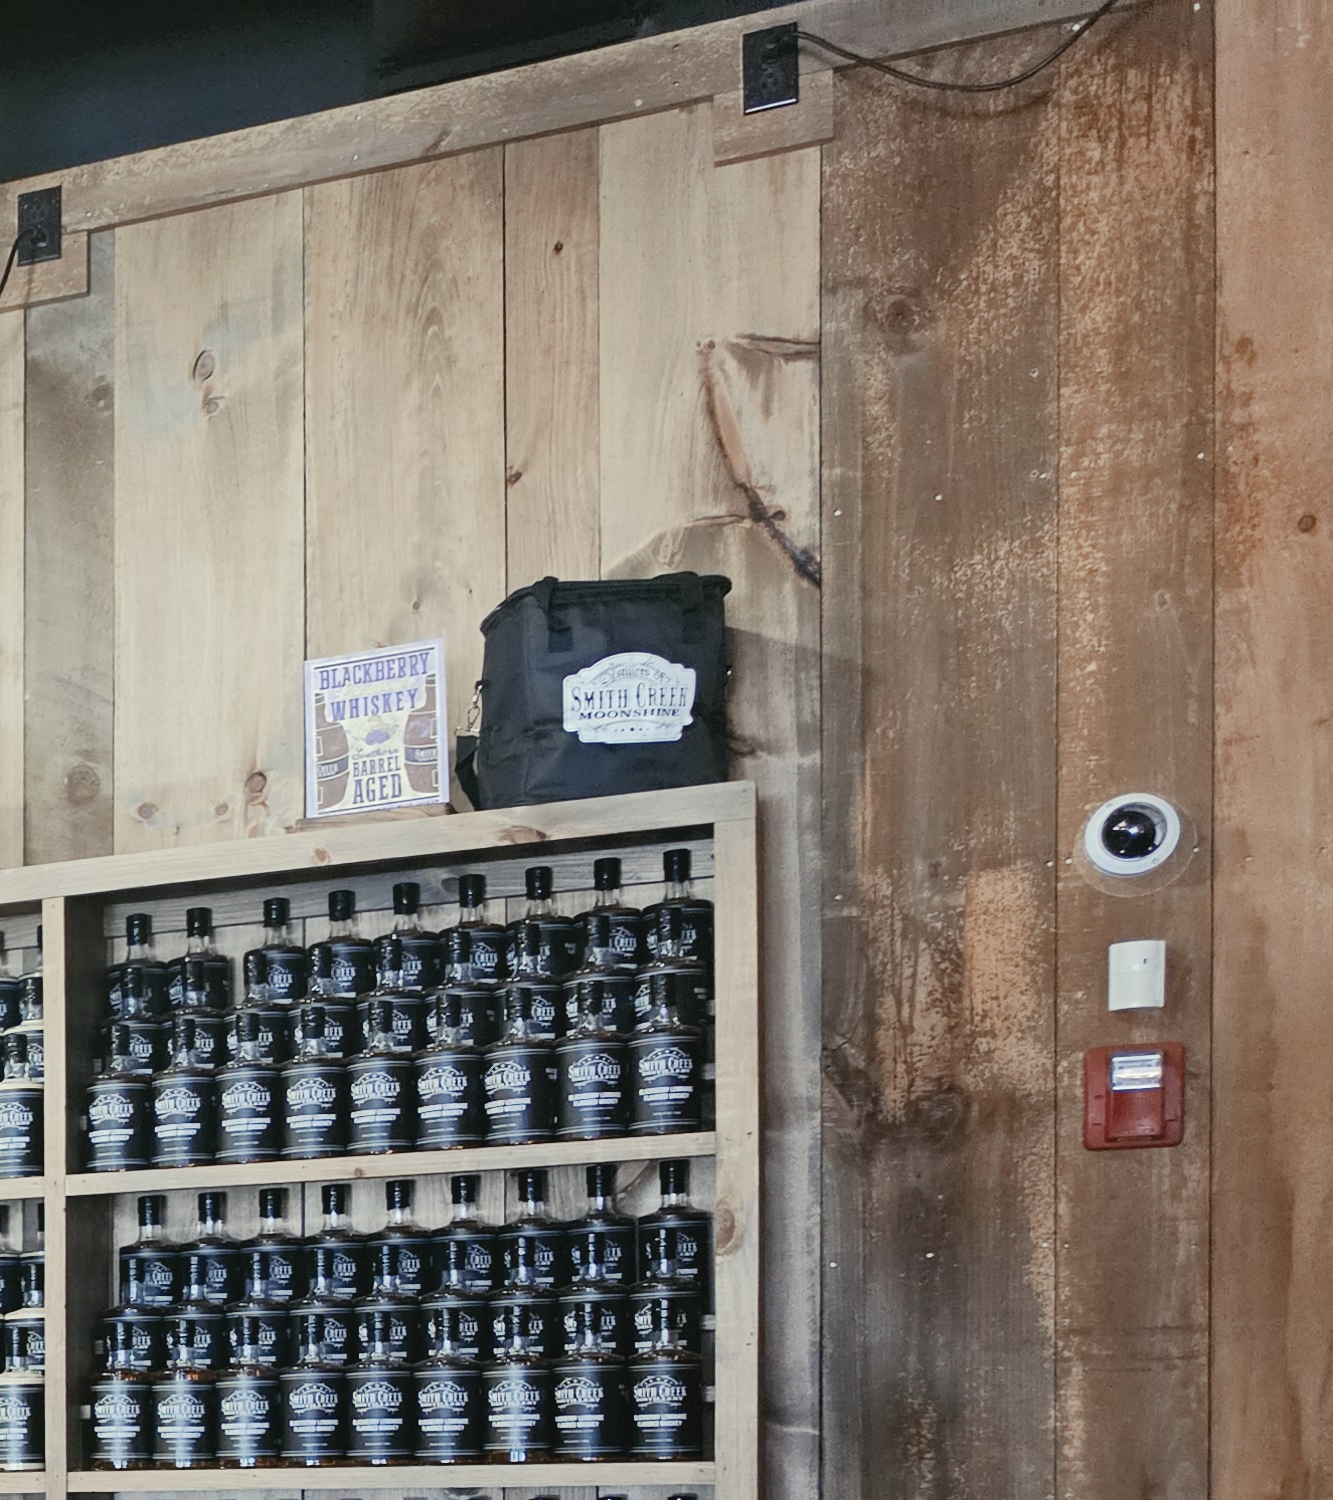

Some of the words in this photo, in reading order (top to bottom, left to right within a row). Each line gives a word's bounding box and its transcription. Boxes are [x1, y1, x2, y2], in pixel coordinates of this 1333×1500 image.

[319, 652, 430, 690] BLACKBERRY
[331, 688, 419, 722] WHISKEY
[571, 686, 628, 713] SMITH
[635, 682, 689, 708] CREEK
[579, 708, 680, 720] MOONSHINE
[352, 756, 401, 777] BARREL
[352, 774, 402, 804] AGED
